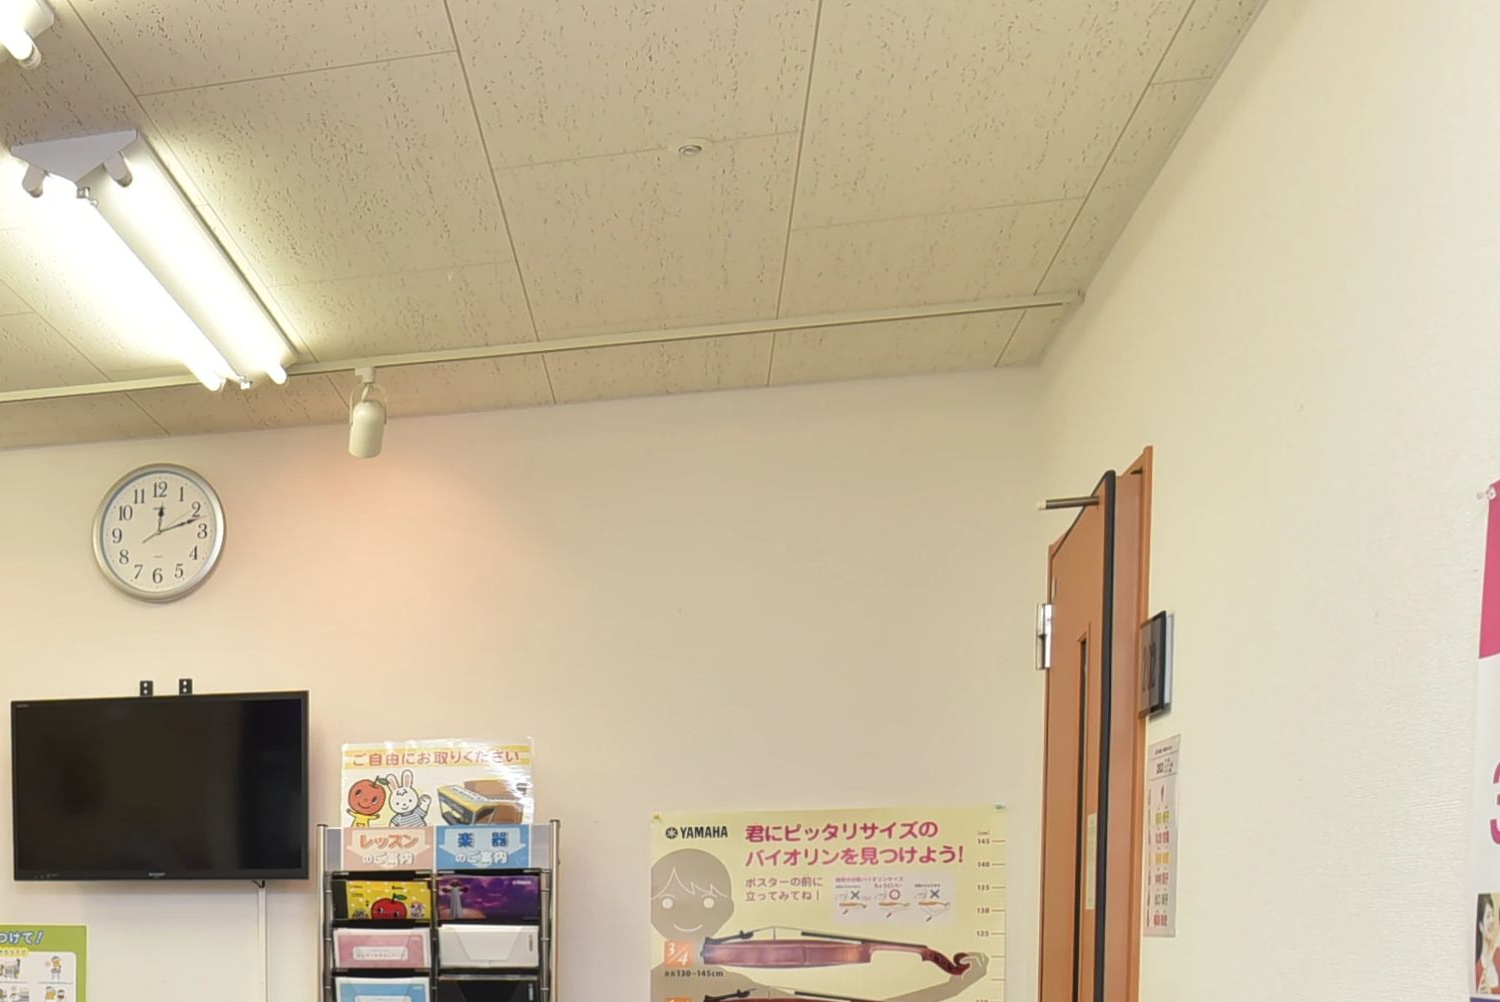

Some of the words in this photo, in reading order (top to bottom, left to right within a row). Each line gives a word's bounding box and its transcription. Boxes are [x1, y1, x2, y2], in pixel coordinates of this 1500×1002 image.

[134, 488, 145, 504] 11
[152, 481, 168, 498] 12
[179, 486, 184, 502] 1
[118, 505, 133, 521] 10
[191, 501, 202, 518] 2
[112, 528, 123, 544] 9
[197, 523, 208, 539] 3
[119, 549, 129, 564] 8
[189, 545, 198, 560] 4
[134, 564, 143, 580] 7
[152, 568, 163, 584] 6
[174, 563, 184, 579] 5
[353, 751, 519, 767] ご自由にお取りください
[457, 832, 509, 847] 楽器
[681, 826, 728, 839] YAMAHA
[745, 821, 938, 843] 君にピッタリサイズの
[360, 834, 419, 849] レッスン
[362, 853, 414, 865] のご案内
[455, 852, 508, 865] のご案内
[745, 846, 964, 867] バイオリンを見つけよう!
[745, 877, 823, 888] ポスターの前に
